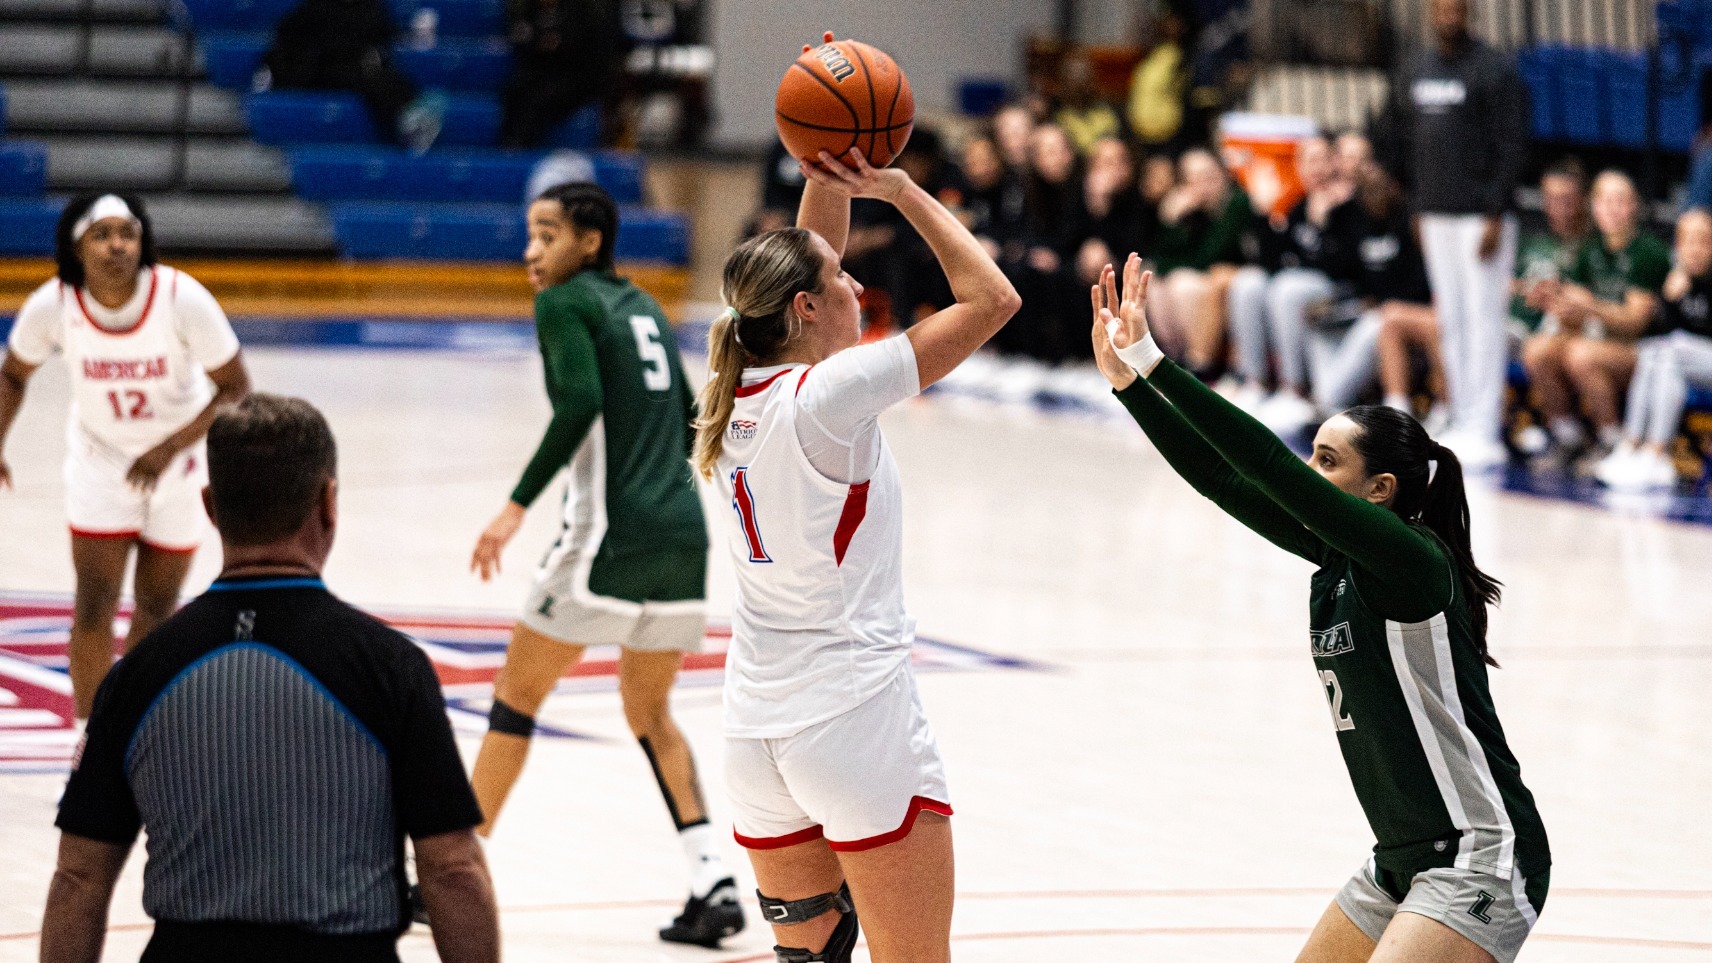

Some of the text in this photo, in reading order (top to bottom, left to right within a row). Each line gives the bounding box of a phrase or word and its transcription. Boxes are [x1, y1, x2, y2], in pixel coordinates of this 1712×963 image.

[629, 315, 671, 391] 5
[108, 390, 154, 420] 12
[730, 467, 774, 563] 1
[1467, 890, 1496, 925] L
